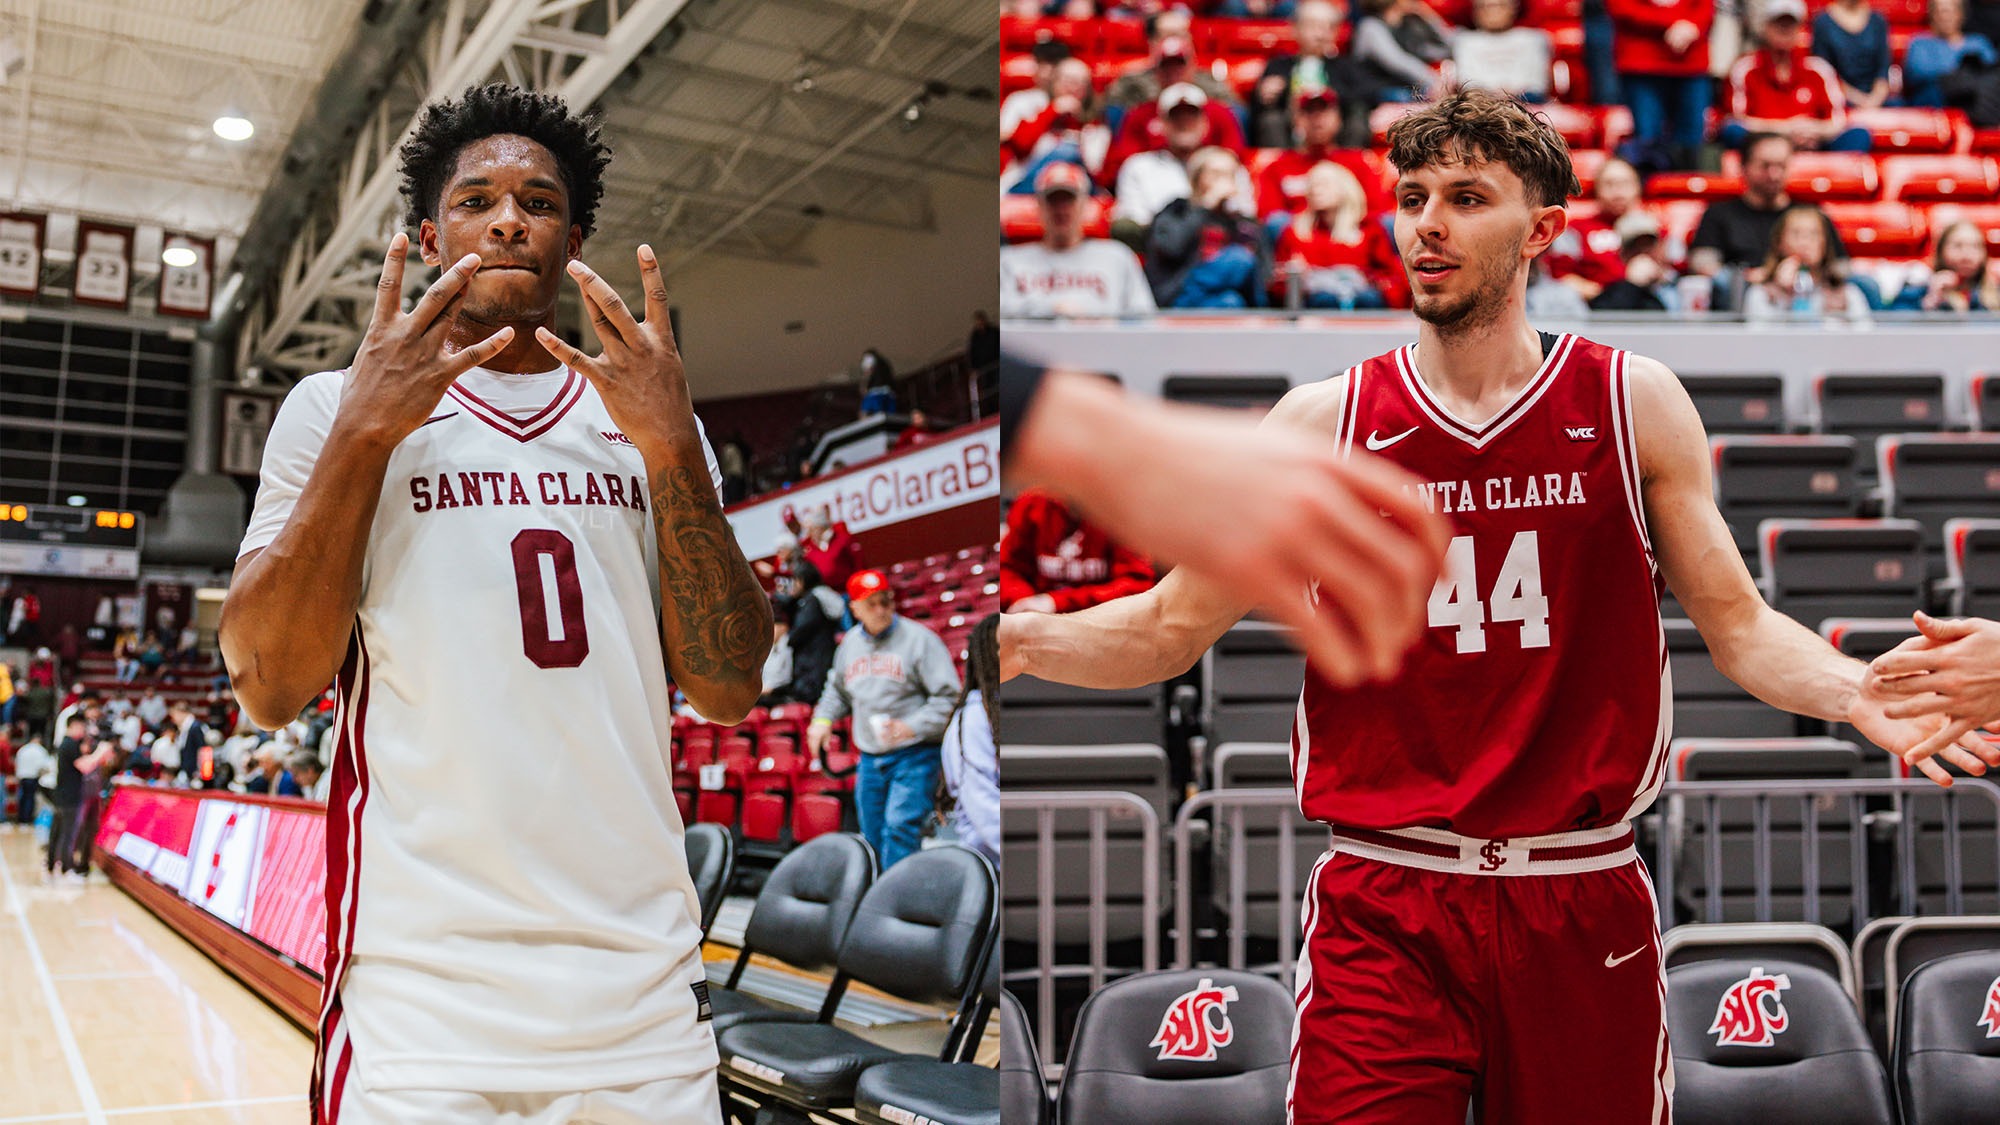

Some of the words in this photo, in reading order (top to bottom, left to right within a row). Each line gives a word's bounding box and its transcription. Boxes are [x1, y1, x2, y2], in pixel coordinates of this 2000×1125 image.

[1565, 427, 1596, 439] WCC
[410, 472, 530, 513] SANTA
[537, 472, 647, 513] CLARA
[1381, 479, 1477, 517] NTA
[1485, 471, 1587, 510] CLARA
[510, 528, 590, 669] 0
[1427, 530, 1551, 654] 44
